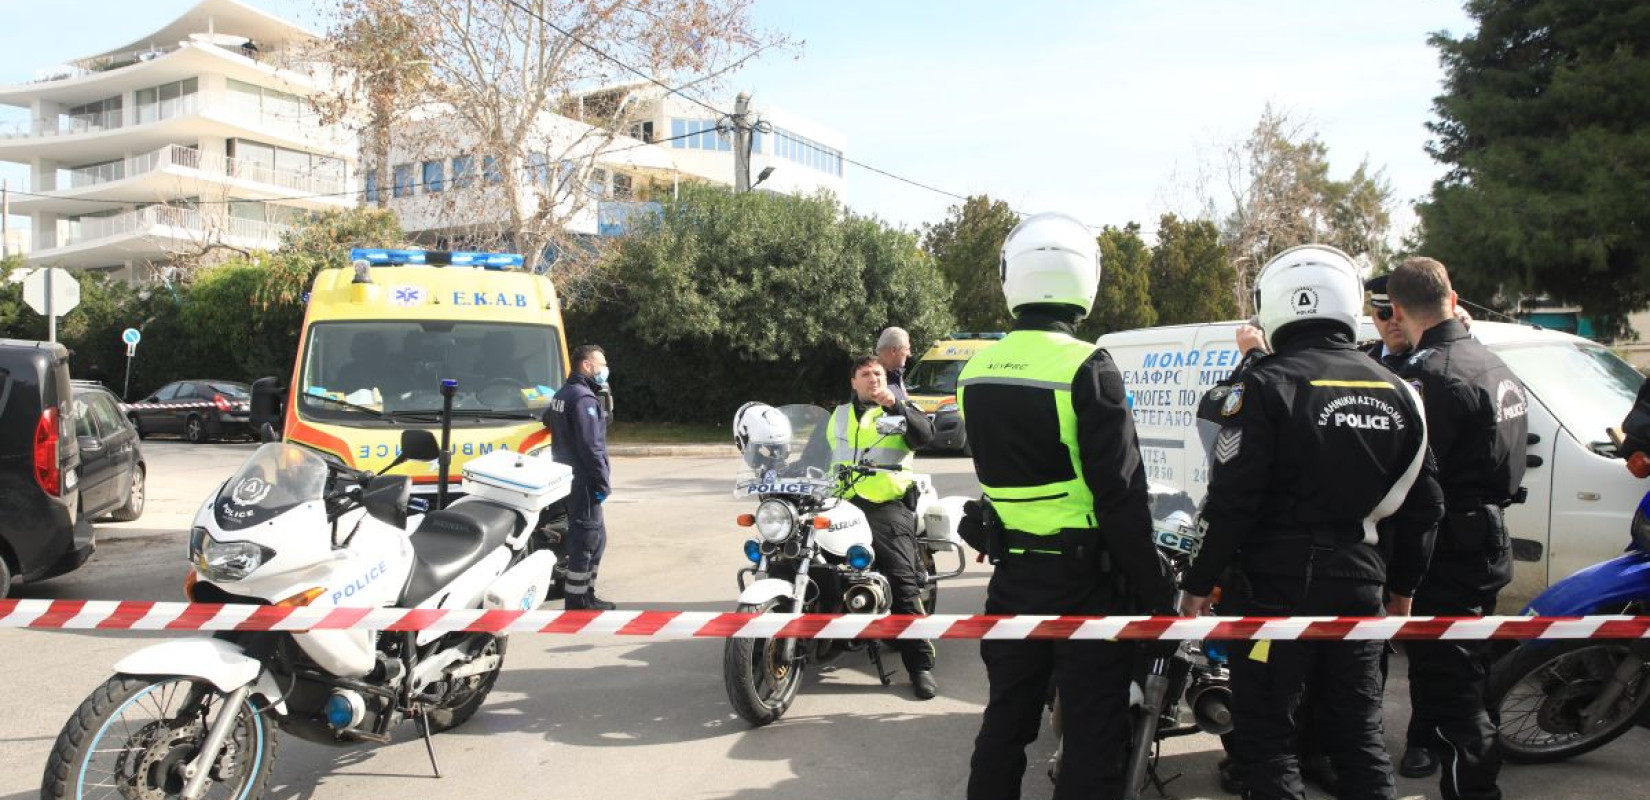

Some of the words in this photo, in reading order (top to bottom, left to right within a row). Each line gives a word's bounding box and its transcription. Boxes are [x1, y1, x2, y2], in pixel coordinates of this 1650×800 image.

[1143, 350, 1239, 368] ΜΟΝΩΣΕΙ
[1334, 413, 1390, 430] POLICE
[747, 483, 810, 494] POLICE
[332, 560, 388, 605] POLICE
